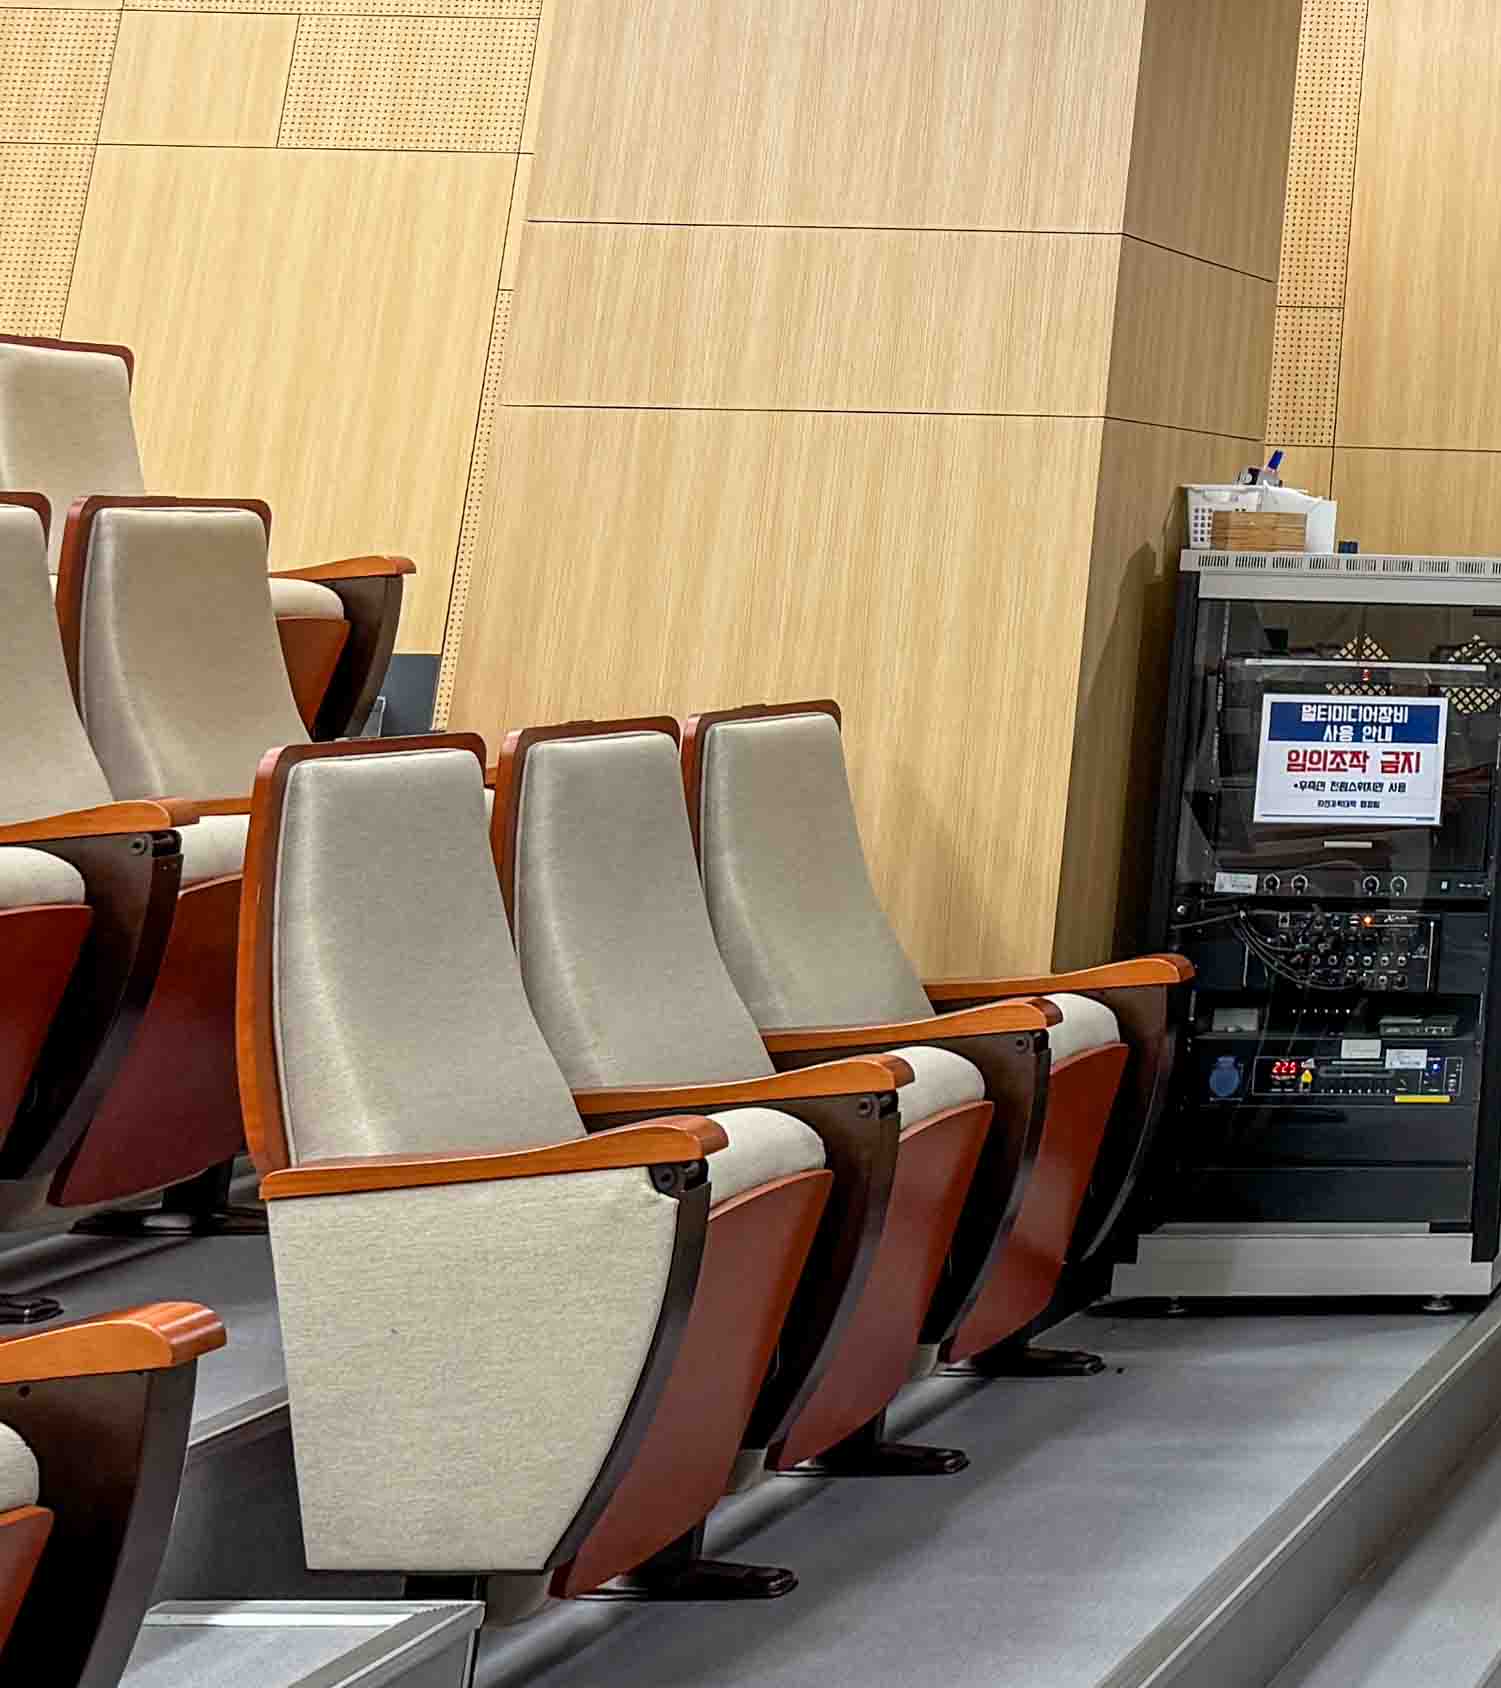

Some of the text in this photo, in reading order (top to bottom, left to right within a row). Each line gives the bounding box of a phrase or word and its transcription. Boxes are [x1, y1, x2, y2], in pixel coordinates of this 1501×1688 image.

[1301, 704, 1408, 724] 멀티미디어장비
[1323, 725, 1393, 743] 사용 안내
[1286, 749, 1421, 774] 임의조작 금지
[1271, 1061, 1297, 1074] 225
